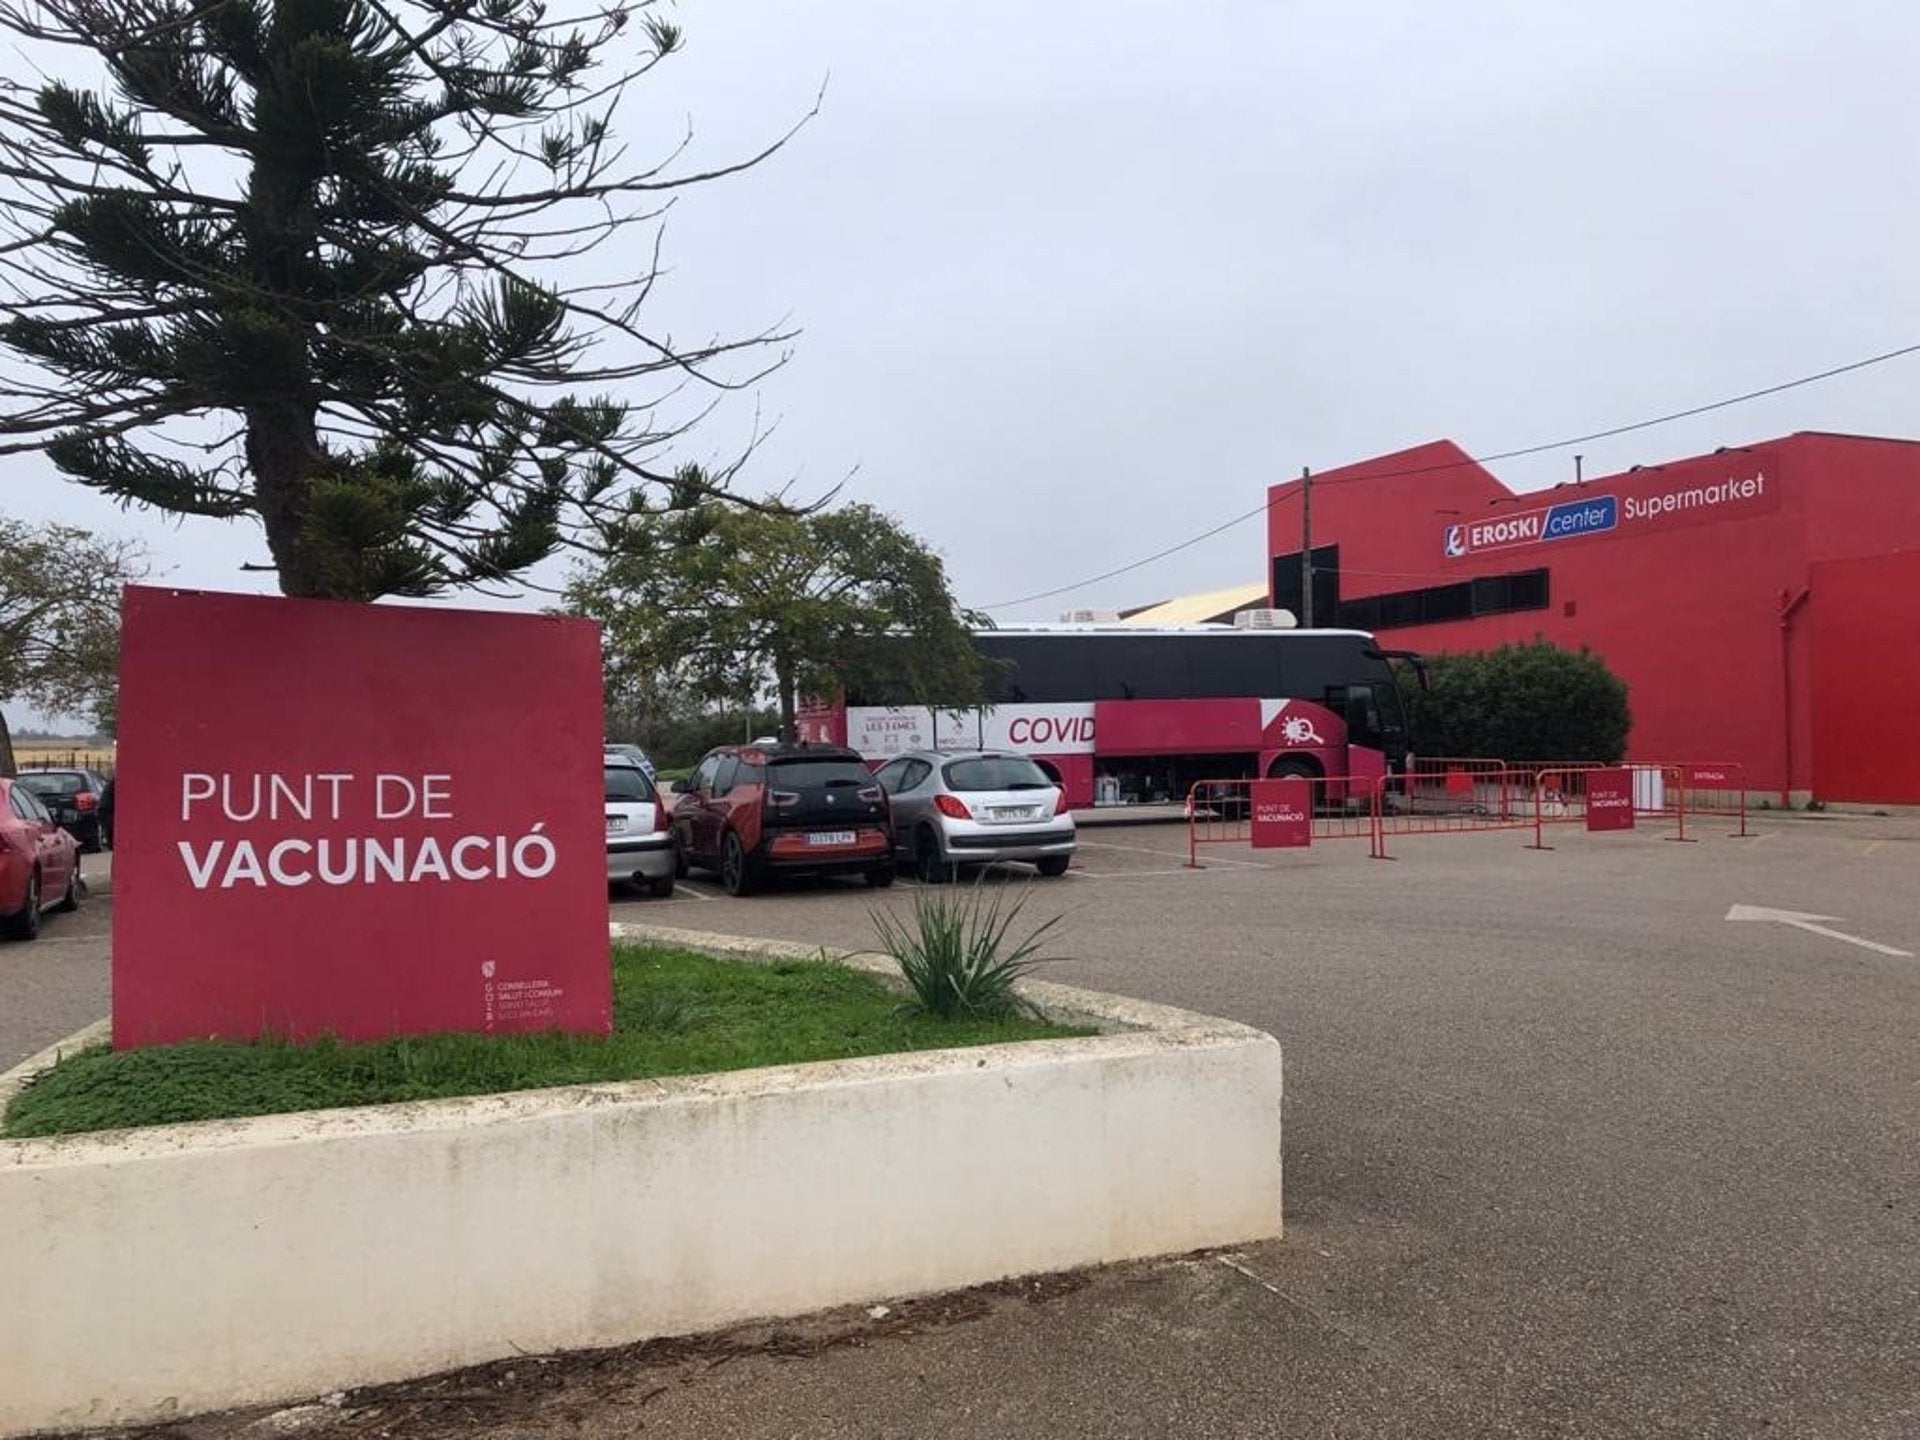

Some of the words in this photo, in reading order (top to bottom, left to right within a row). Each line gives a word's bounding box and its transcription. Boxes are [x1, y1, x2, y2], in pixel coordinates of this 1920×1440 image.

[1472, 516, 1539, 547] EROSKI
[1550, 505, 1608, 534] center
[1625, 472, 1765, 521] Supermarket
[1009, 716, 1095, 744] COVID
[181, 773, 354, 822] PUNT
[376, 773, 453, 820] DE
[177, 822, 557, 889] VACUNACIÓ
